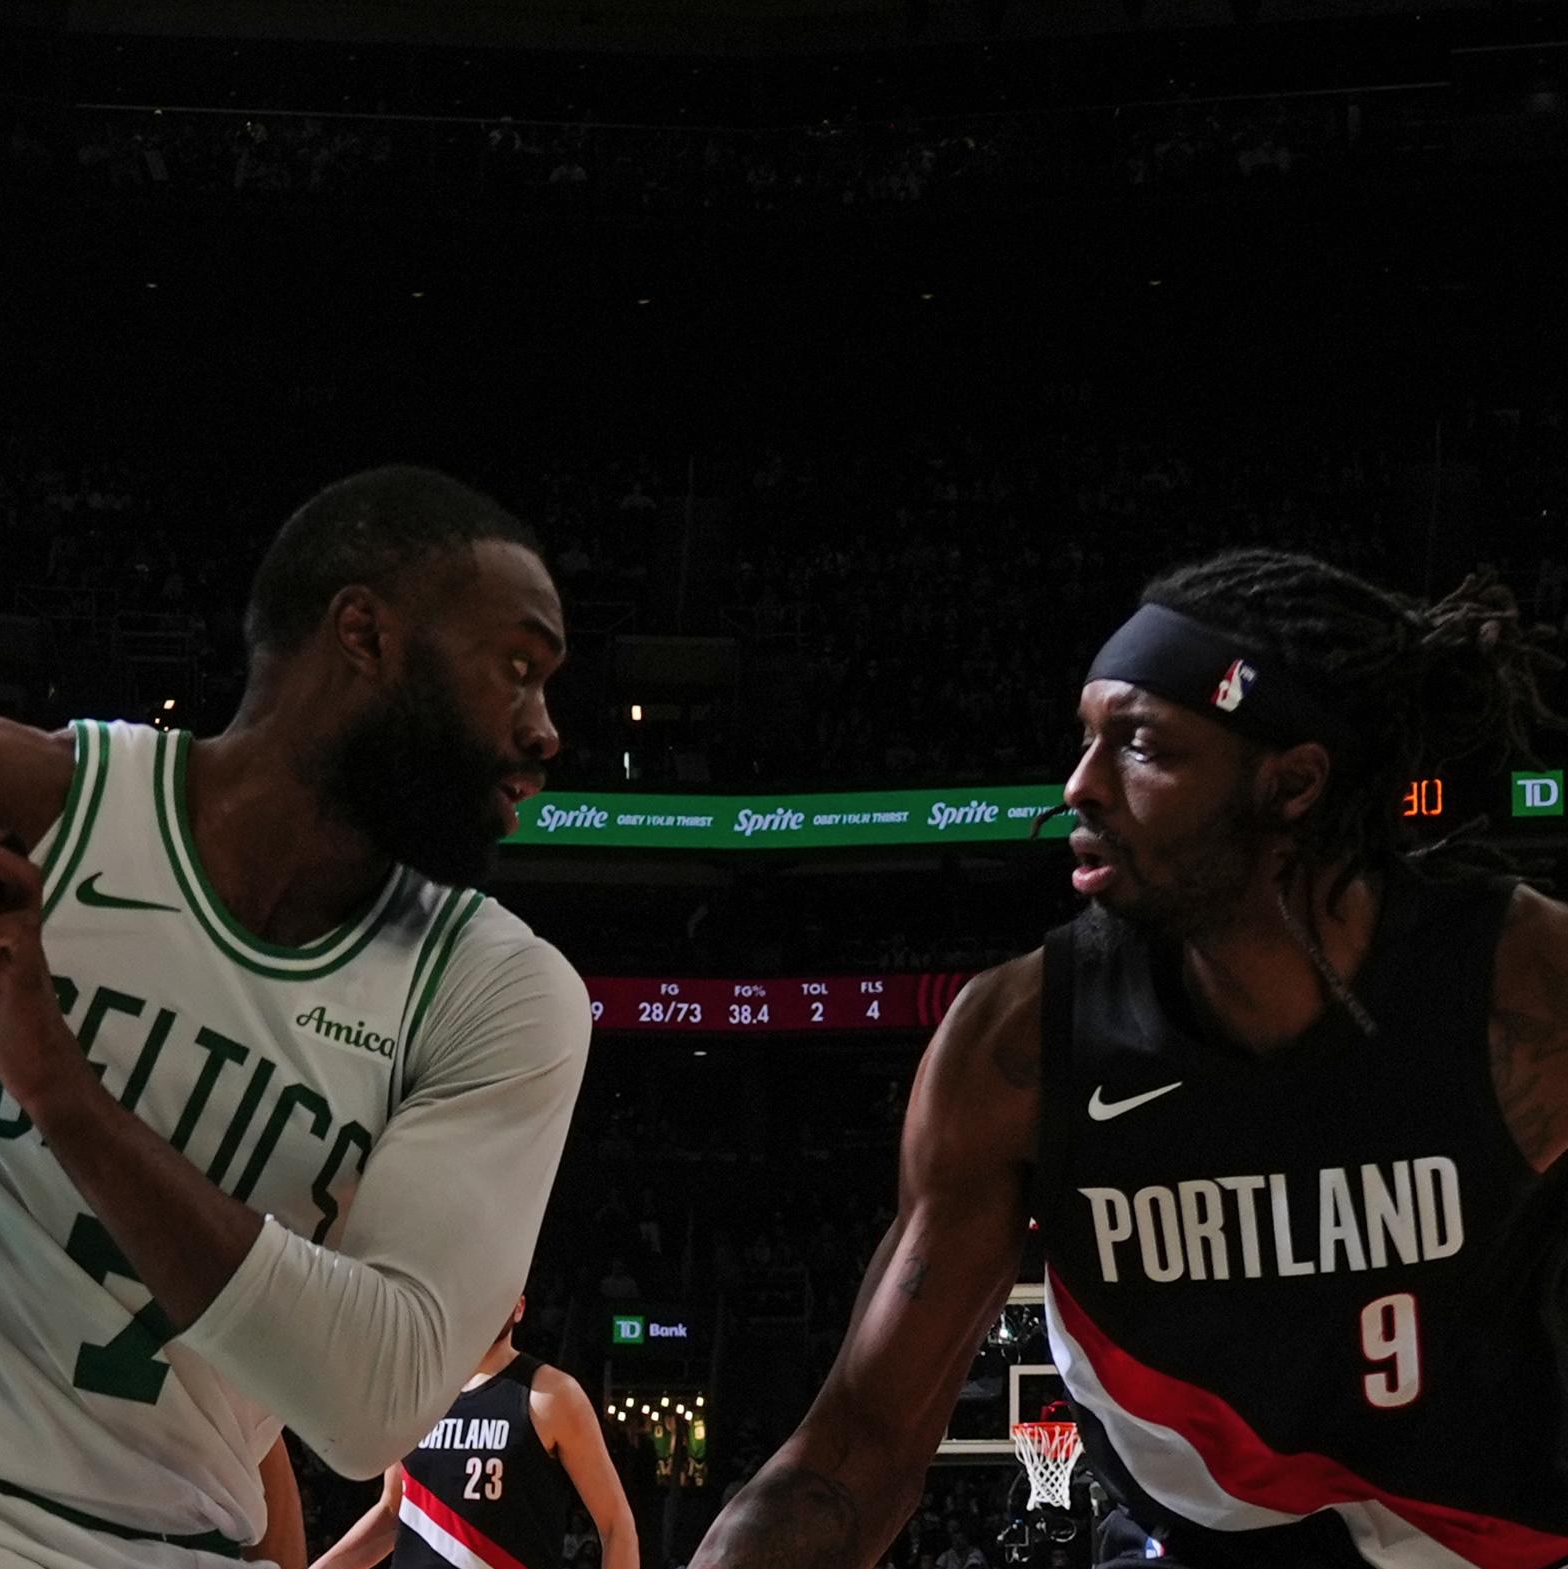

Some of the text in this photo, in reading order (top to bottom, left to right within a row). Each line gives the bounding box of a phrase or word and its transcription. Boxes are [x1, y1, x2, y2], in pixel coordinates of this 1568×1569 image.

[1516, 778, 1559, 808] TD
[536, 804, 609, 832] Sprite
[733, 807, 805, 837] Sprite
[927, 800, 999, 830] Sprite
[659, 983, 680, 997] FG
[733, 984, 767, 999] FG%
[801, 982, 829, 996] TOL
[859, 980, 884, 994] FLS
[638, 1001, 703, 1024] 28/73
[728, 1003, 770, 1025] 38.4
[810, 1001, 825, 1023] 2
[865, 999, 881, 1021] 4
[295, 1005, 396, 1059] Amica
[1077, 1155, 1465, 1284] PORTLAND
[65, 1212, 171, 1406] 7
[615, 1320, 688, 1339] TD Bank
[1360, 1292, 1424, 1410] 9
[417, 1417, 511, 1451] RTLAND
[462, 1456, 504, 1500] 23
